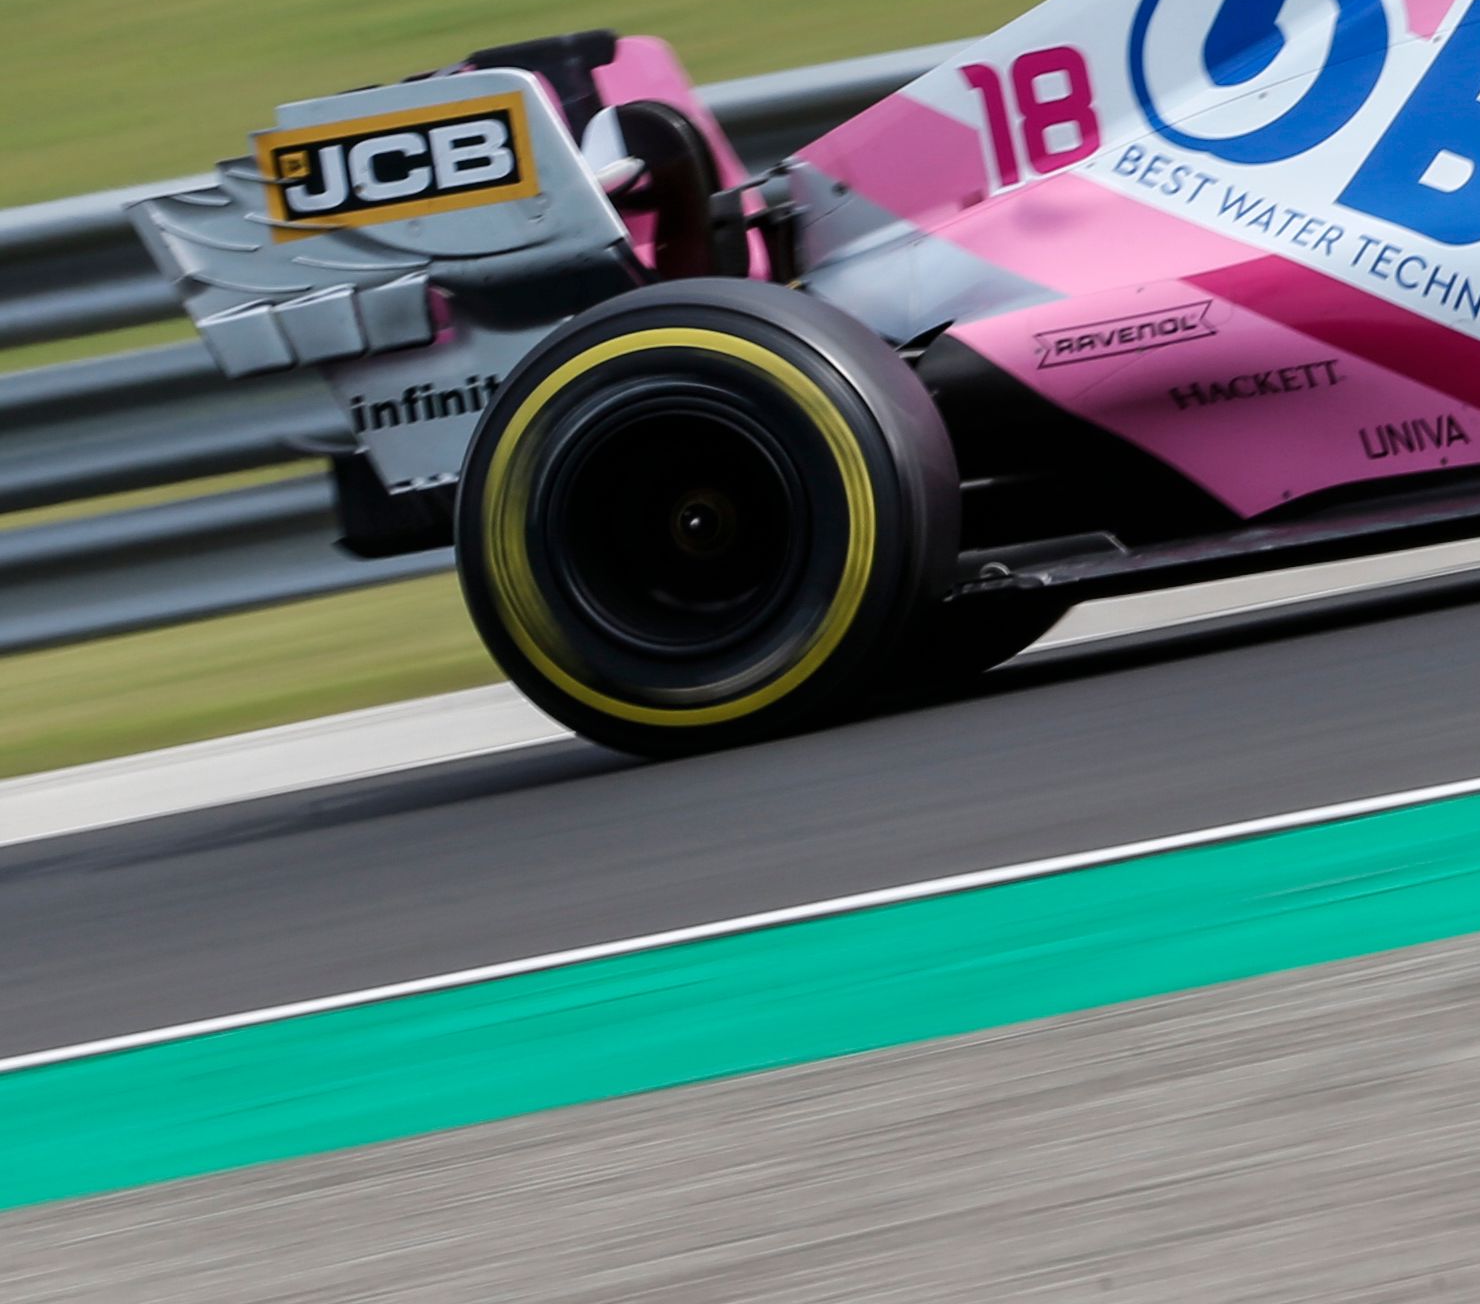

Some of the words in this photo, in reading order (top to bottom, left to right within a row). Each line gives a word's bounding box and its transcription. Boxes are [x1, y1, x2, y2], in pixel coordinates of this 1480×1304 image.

[958, 45, 1099, 184] 18
[285, 117, 514, 212] JCB
[1114, 144, 1218, 203] BEST
[1221, 185, 1344, 256] WATER
[1054, 315, 1197, 356] RAVENOL
[351, 373, 500, 433] infinit
[1169, 359, 1339, 409] HACKETT
[1358, 414, 1470, 460] UNIVA
